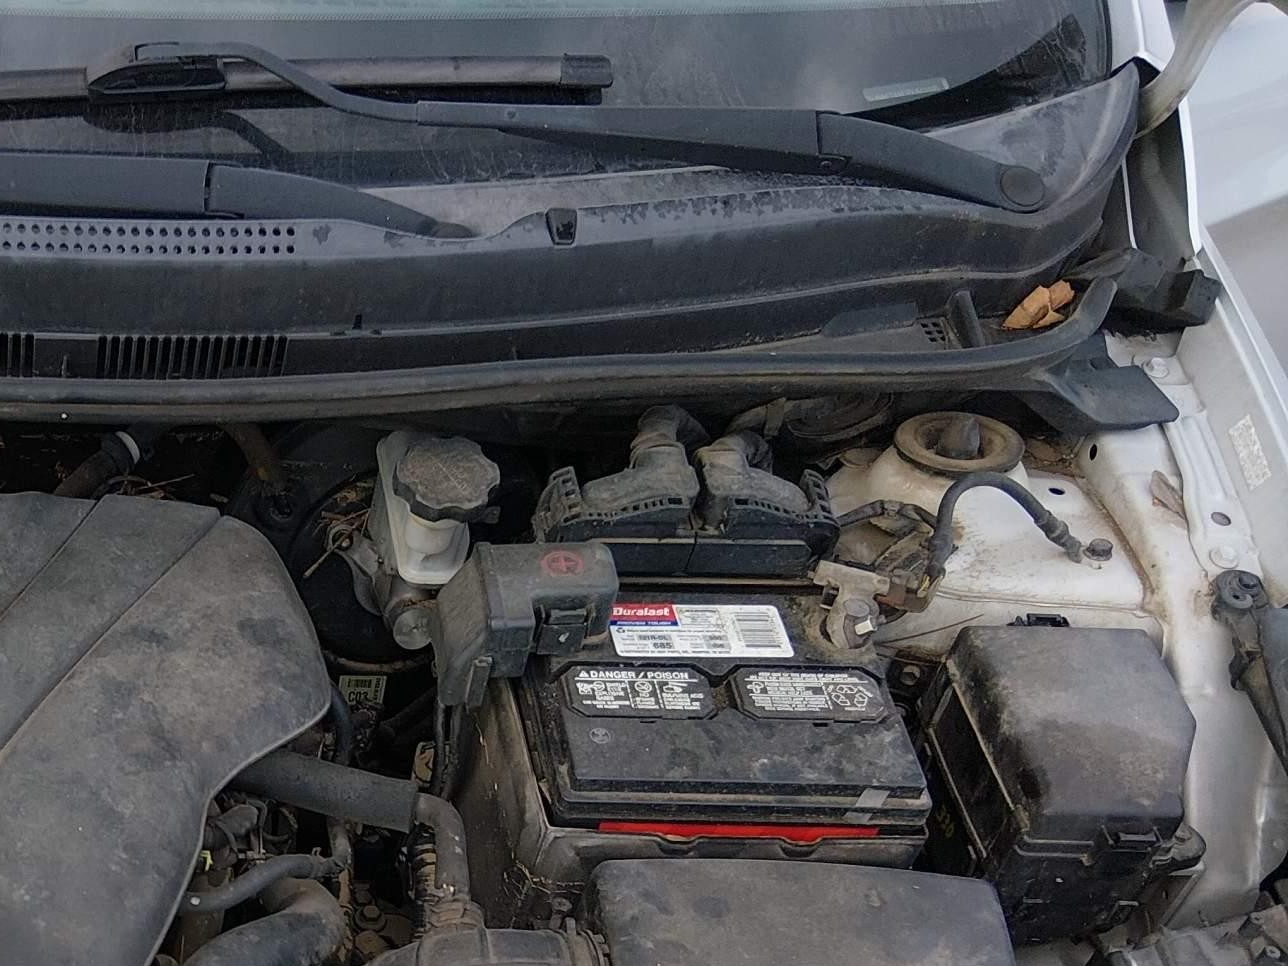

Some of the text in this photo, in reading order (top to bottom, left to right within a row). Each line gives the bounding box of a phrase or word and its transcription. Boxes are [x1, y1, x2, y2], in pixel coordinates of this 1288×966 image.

[612, 606, 670, 616] Duralast
[590, 670, 636, 679] DANGER
[646, 671, 689, 680] POISON
